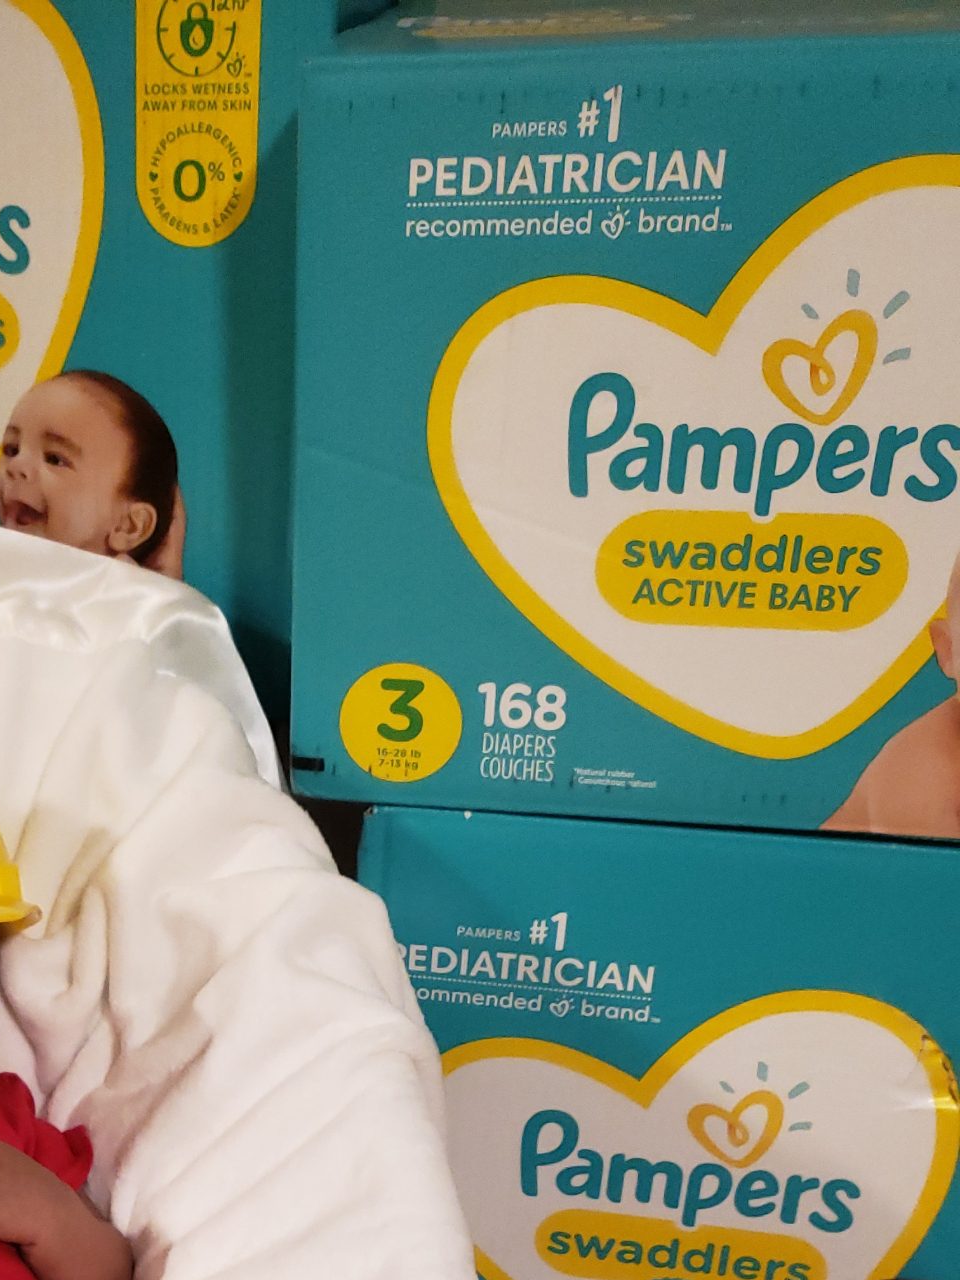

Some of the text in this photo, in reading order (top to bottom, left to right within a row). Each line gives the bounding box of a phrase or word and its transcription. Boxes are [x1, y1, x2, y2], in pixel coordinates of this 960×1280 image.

[142, 100, 252, 112] AWAY FROM SKIN
[144, 82, 250, 95] LOCKS WETNESS
[492, 85, 623, 143] PAMPERS #1
[151, 122, 242, 167] HYPOALLERGENIC
[408, 149, 727, 197] PEDIATRICIAN
[150, 188, 198, 236] PARABENS
[405, 210, 593, 238] recommended
[568, 372, 960, 517] Pampers
[622, 534, 883, 576] swaddlers
[632, 579, 861, 613] ACTIVE BABY
[377, 678, 425, 742] 3
[478, 682, 567, 731] 168
[482, 733, 556, 758] DIAPERS
[479, 756, 554, 782] COUCHES
[457, 912, 568, 951] PAMPERS #1
[416, 986, 542, 1012] ommended
[521, 1109, 861, 1233] Pampers
